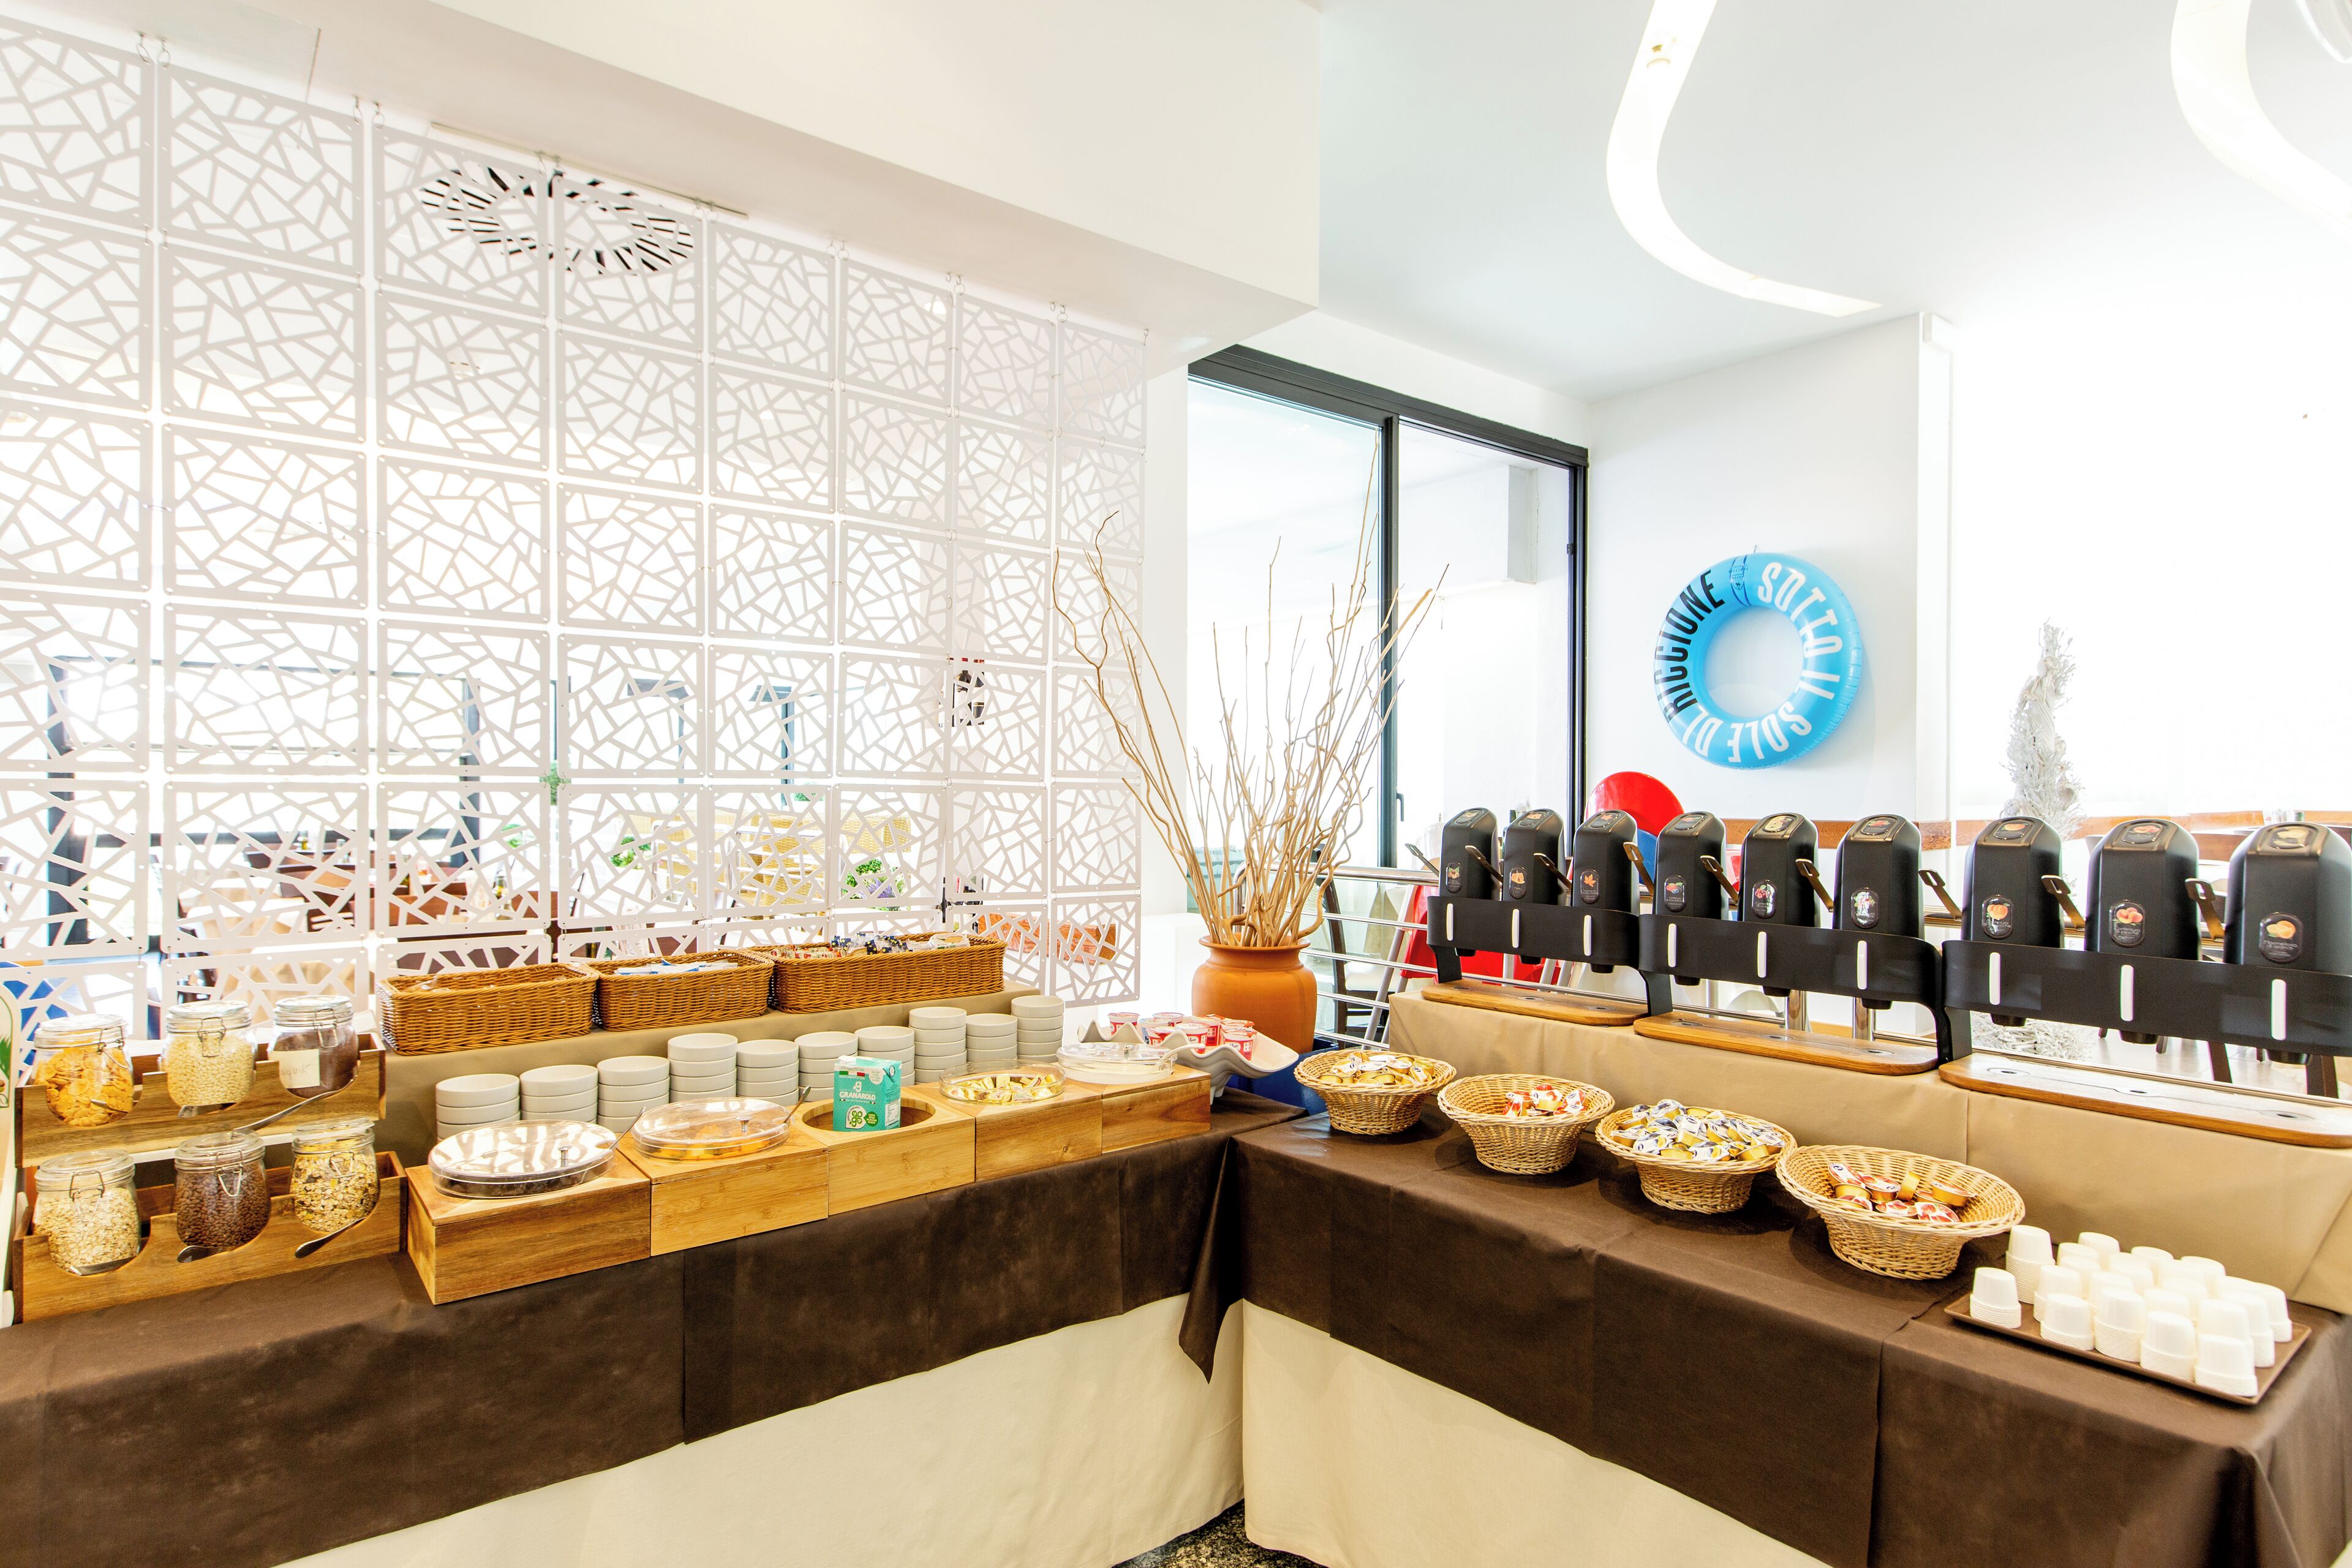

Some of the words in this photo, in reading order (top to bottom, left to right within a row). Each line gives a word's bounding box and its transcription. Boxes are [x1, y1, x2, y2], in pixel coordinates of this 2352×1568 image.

[1758, 562, 1842, 658] SOTTO
[1654, 570, 1725, 723] RICCIONE
[1794, 670, 1840, 700] IL
[1683, 704, 1723, 757] DI
[1728, 701, 1812, 763] SOLE
[839, 1091, 876, 1101] GRANAROLO
